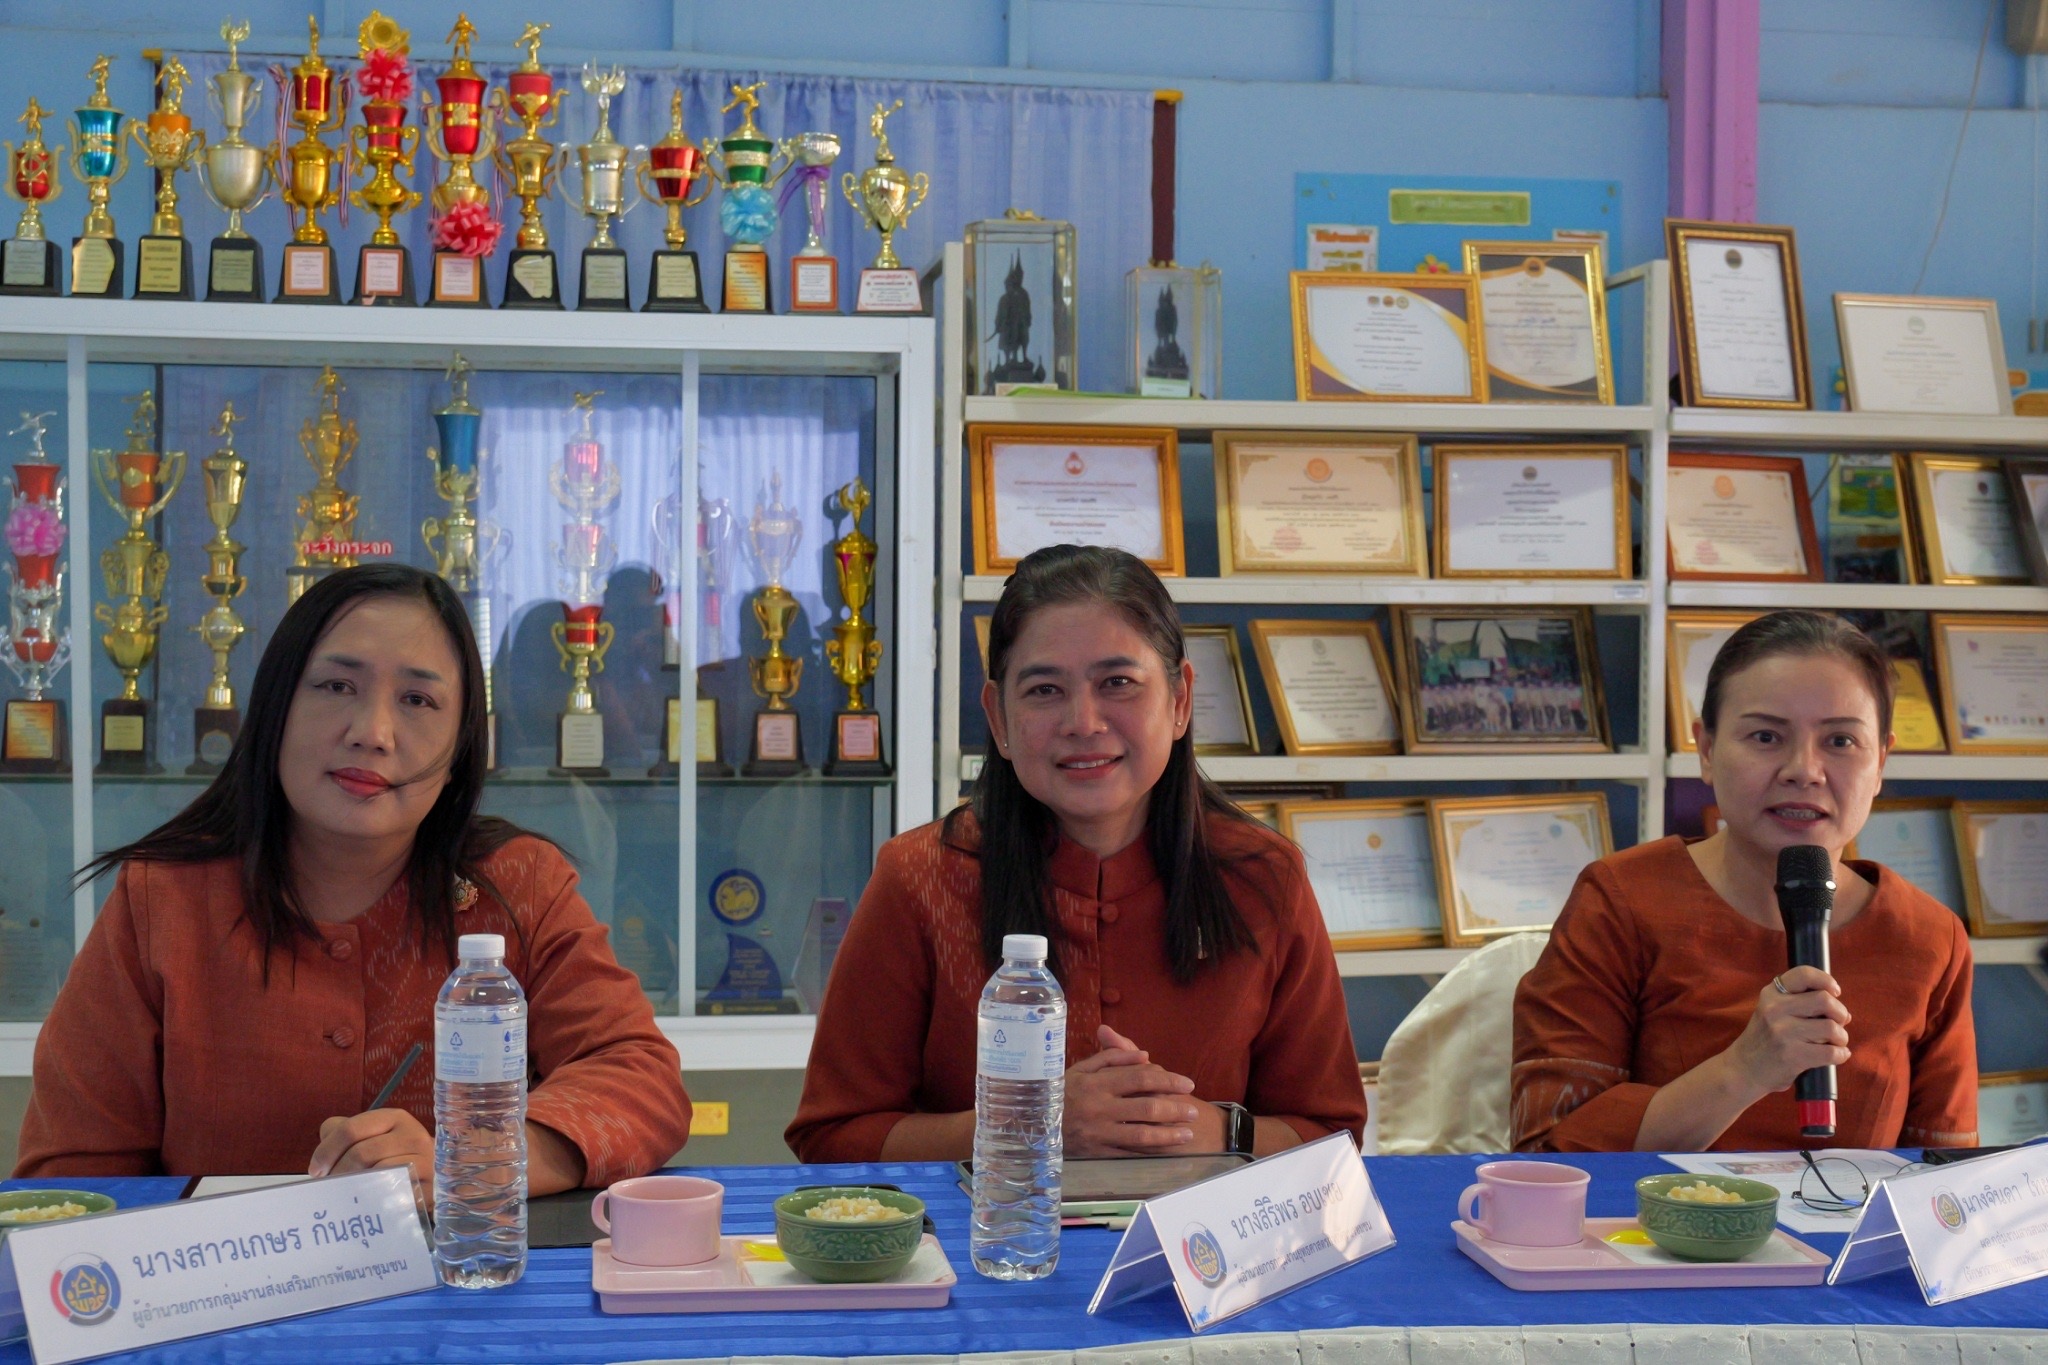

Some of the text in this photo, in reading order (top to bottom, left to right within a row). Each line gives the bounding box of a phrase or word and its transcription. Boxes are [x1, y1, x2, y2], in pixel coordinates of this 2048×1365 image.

[1231, 1195, 1299, 1240] นางสิริพร
[1963, 1185, 2021, 1213] นางจินดา
[132, 1197, 385, 1279] นางสาวเกษร กันสุ่ม
[132, 1257, 409, 1329] ผู้อำนวยการกลุ่มงานส่งเสริมการพัฒนาชุมชน
